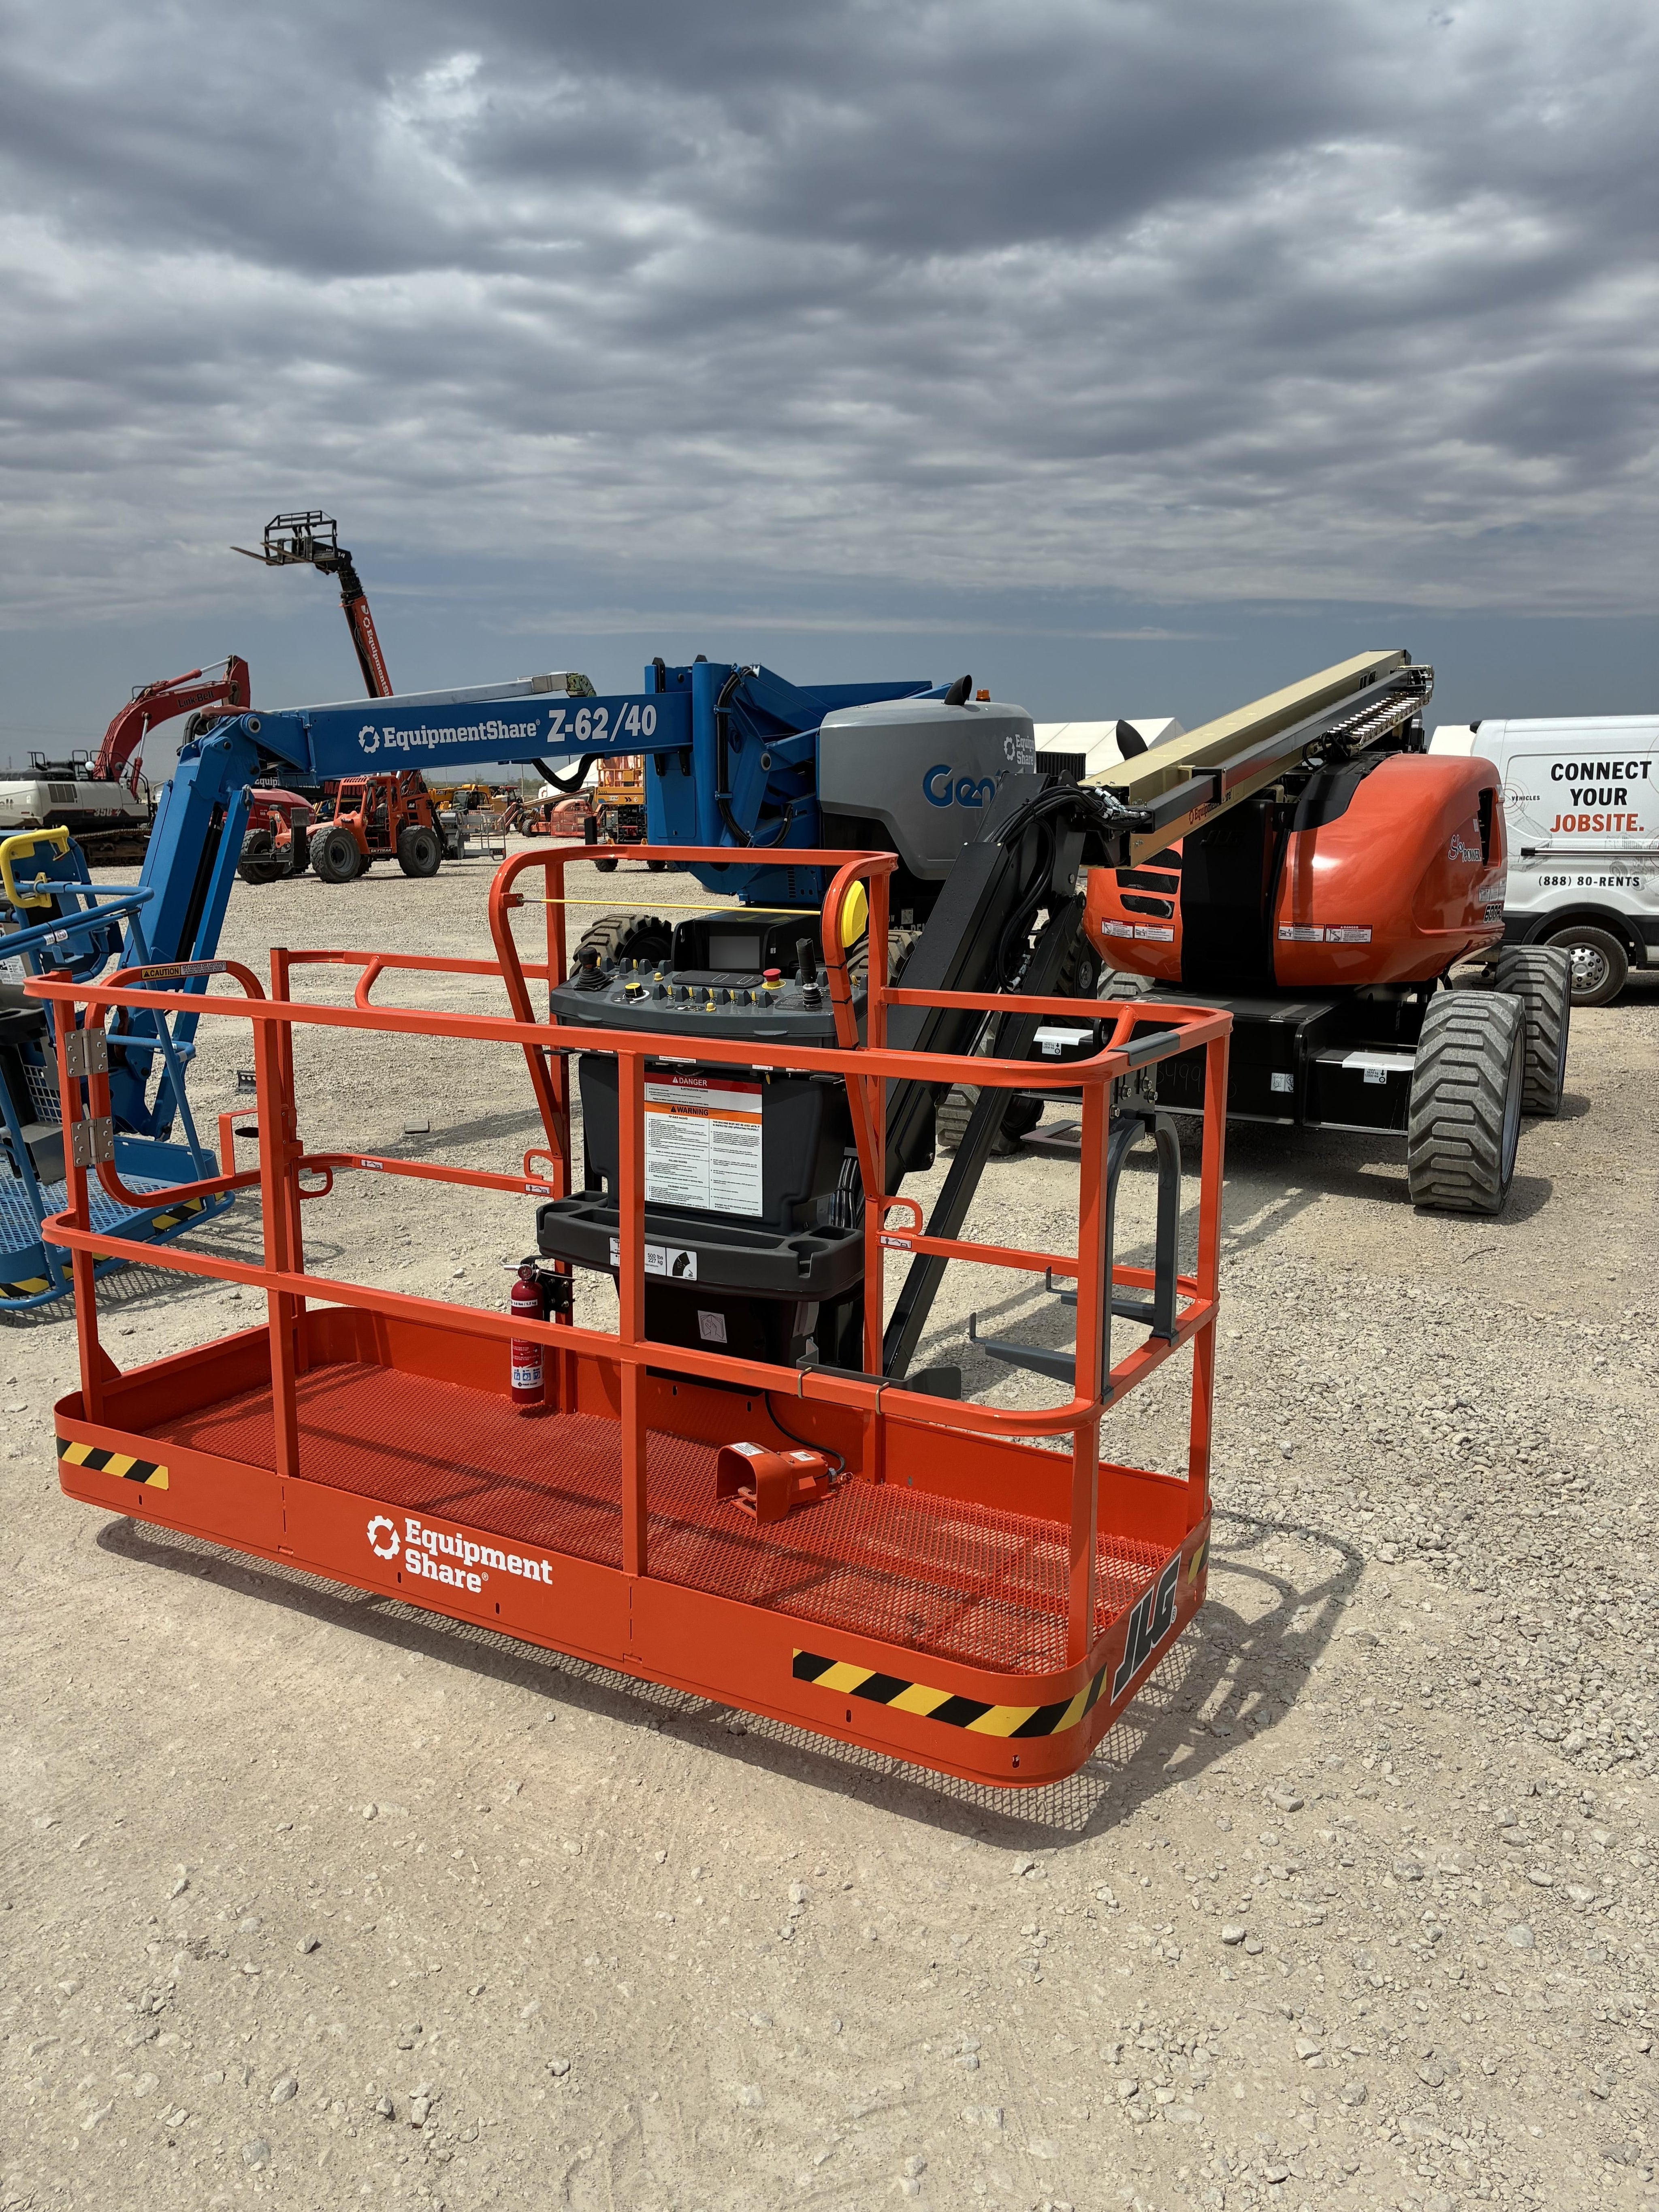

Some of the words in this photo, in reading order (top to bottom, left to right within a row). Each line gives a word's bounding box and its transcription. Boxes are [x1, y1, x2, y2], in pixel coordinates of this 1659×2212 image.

[547, 702, 657, 742] Z-62/40
[1015, 734, 1034, 752] Equip
[1551, 761, 1652, 781] CONNECT
[1570, 787, 1627, 806] YOUR
[1550, 813, 1644, 832] JOBSITE.
[1539, 876, 1572, 886] (888)
[1577, 876, 1640, 887] 80-RENTS
[150, 967, 179, 977] CAUTION
[679, 1077, 707, 1086] DANGER
[677, 1106, 709, 1116] WARNING
[405, 1517, 553, 1585] Equipment
